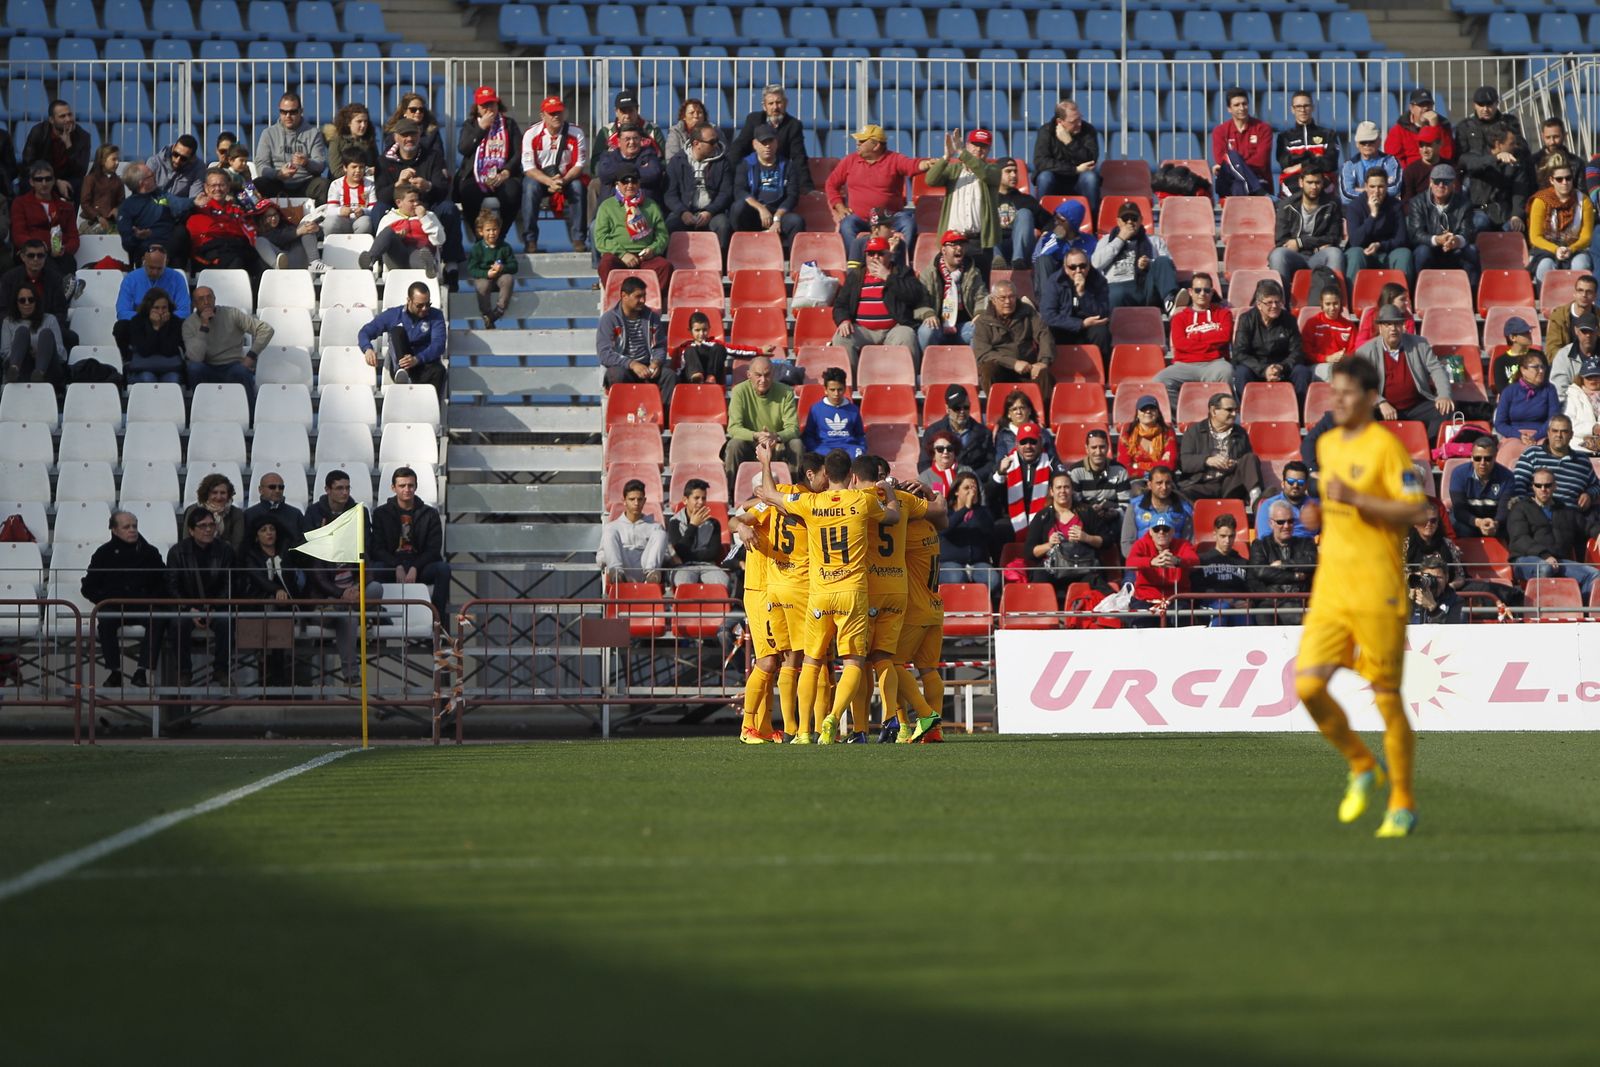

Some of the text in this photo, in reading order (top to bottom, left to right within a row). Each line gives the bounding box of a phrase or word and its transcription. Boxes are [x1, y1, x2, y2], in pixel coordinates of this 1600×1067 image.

[812, 506, 859, 517] MANUEL S.
[773, 512, 798, 554] 15
[820, 525, 850, 564] 14
[878, 523, 894, 557] 5
